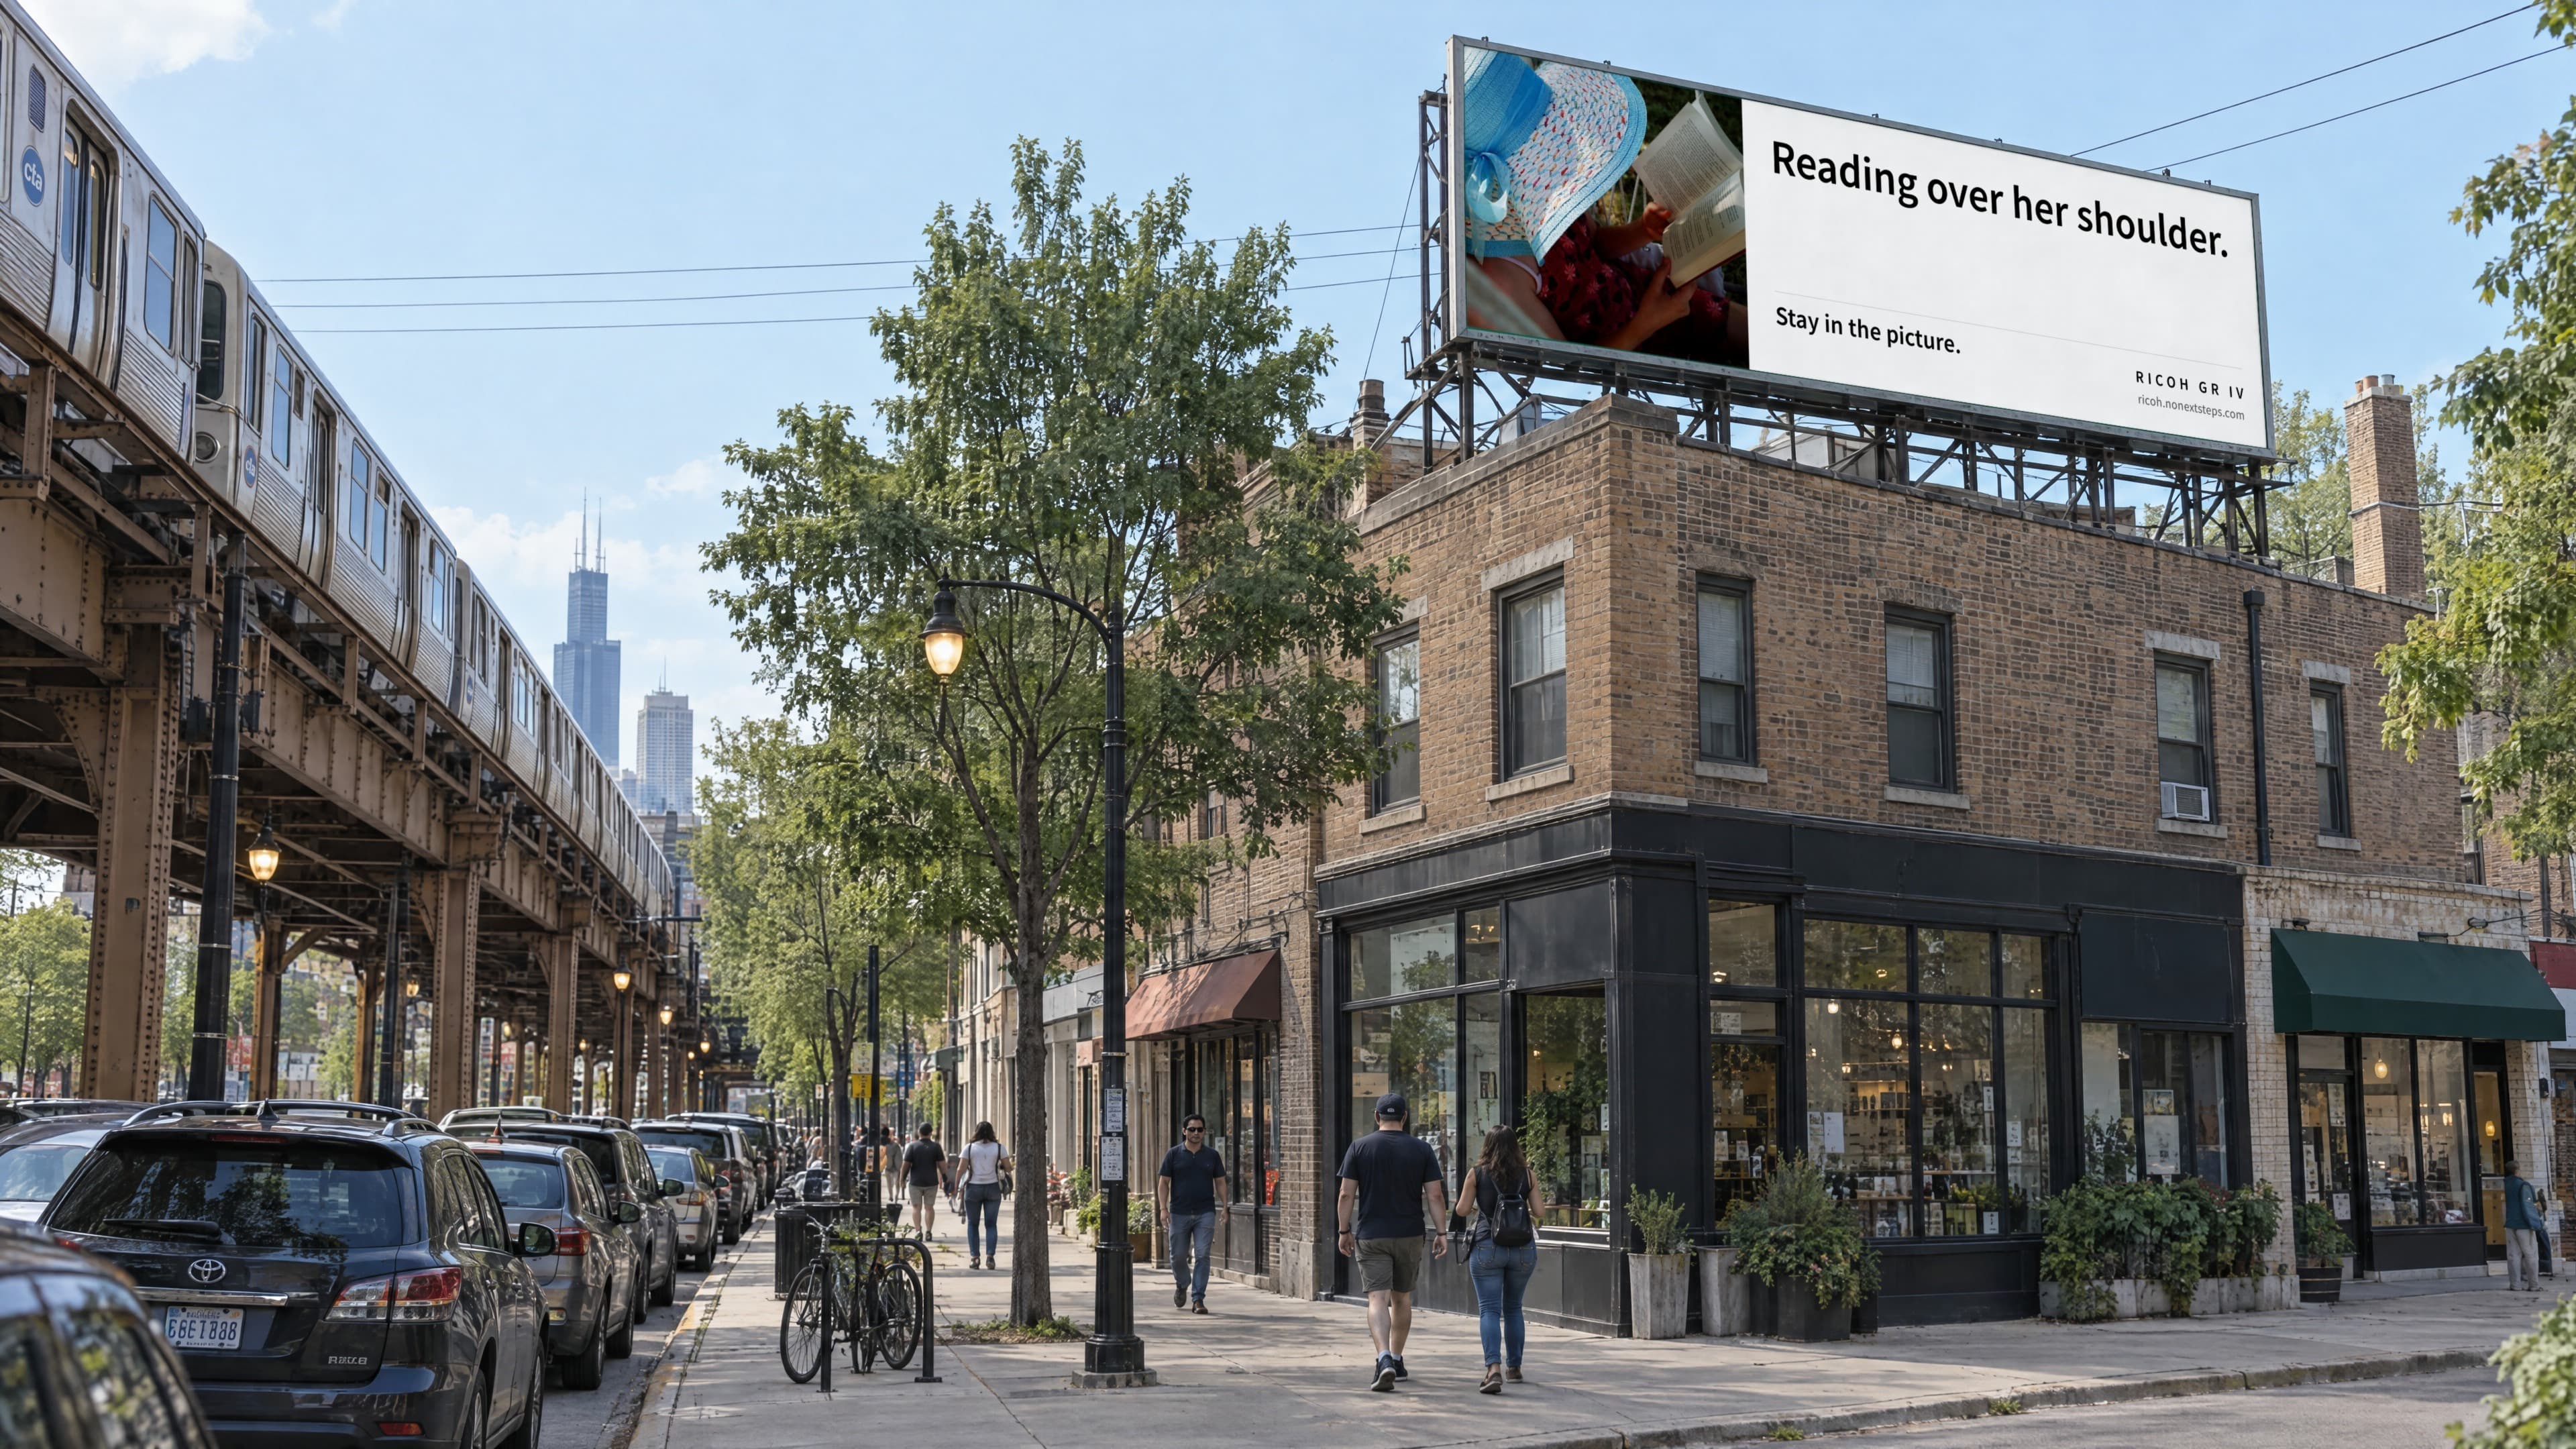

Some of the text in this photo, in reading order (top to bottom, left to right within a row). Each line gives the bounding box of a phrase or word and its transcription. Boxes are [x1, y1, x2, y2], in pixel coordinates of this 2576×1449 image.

[24, 162, 43, 192] cta
[1773, 140, 1919, 209] Reading
[1927, 178, 2004, 215] over
[2012, 184, 2069, 227] her
[2078, 200, 2228, 258] shoulder.
[1776, 307, 1961, 354] Stay in the picture.
[2136, 370, 2245, 399] RICOH GR IV
[2138, 394, 2245, 421] ricoh.nonextsteps.com
